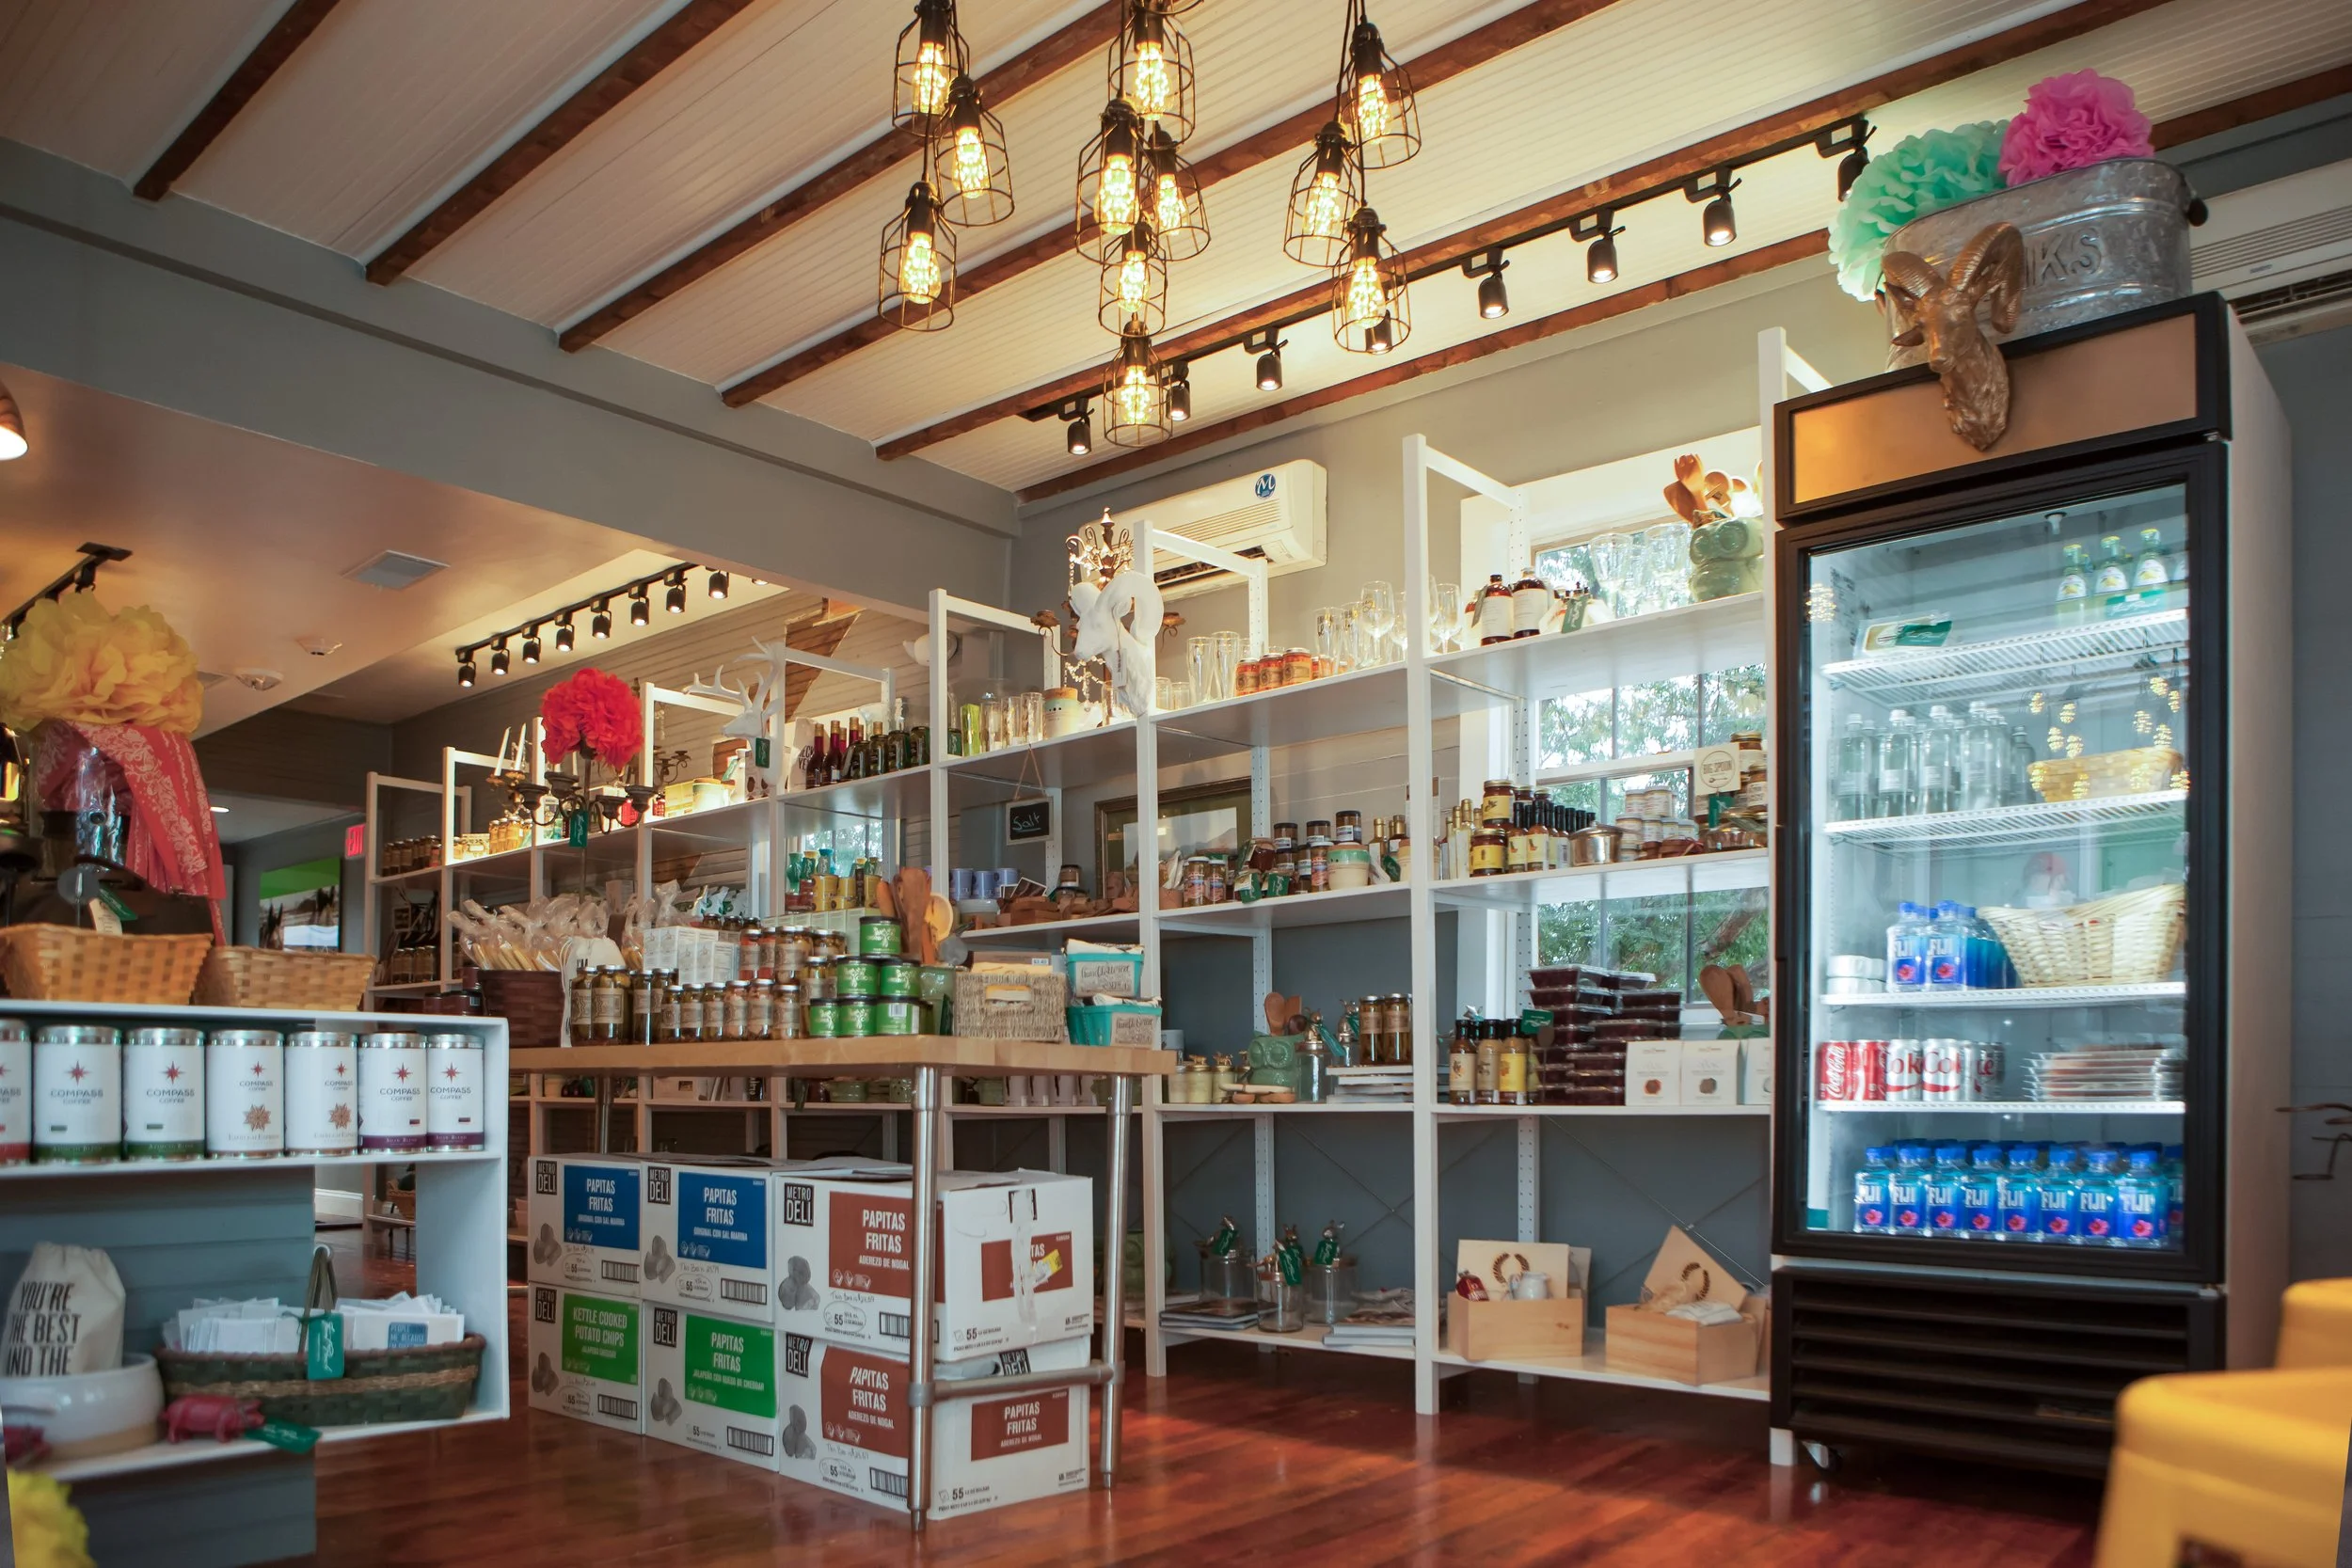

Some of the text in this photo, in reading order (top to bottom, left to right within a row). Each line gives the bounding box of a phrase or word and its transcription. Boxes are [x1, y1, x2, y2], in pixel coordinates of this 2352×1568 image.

[1012, 812, 1041, 831] Salt
[346, 824, 365, 856] EXIT
[51, 1088, 103, 1098] COMPASS
[147, 1088, 195, 1097] COMPASS
[379, 1087, 421, 1096] COMPASS
[537, 1163, 556, 1175] METRO
[649, 1168, 669, 1182] METRO
[586, 1178, 615, 1195] PAPITAS
[787, 1185, 811, 1201] METRO
[1893, 1185, 1916, 1204] FIJI
[589, 1196, 613, 1212] FRITAS
[704, 1187, 738, 1206] PAPITAS
[1929, 1187, 1952, 1206] FIJI
[1965, 1188, 1989, 1206] FIJI
[2041, 1191, 2067, 1209] FIJI
[2080, 1192, 2106, 1211] FIJI
[707, 1207, 735, 1226] FRITAS
[862, 1209, 906, 1232] PAPITAS
[693, 1227, 748, 1242] ORIGINAL CON SAL MARINA
[866, 1232, 902, 1254] FRITAS
[859, 1255, 910, 1271] ADEREZO DE NOGAL
[686, 1280, 693, 1291] 55
[20, 1281, 74, 1311] YOU'RE
[537, 1290, 555, 1303] METRO
[573, 1307, 628, 1329] KETTLE COOKED
[656, 1309, 676, 1324] METRO
[834, 1313, 844, 1325] 55
[34, 1312, 82, 1345] BEST
[575, 1324, 625, 1347] POTATO CHIPS
[966, 1327, 977, 1340] 55
[710, 1332, 744, 1354] PAPITAS
[787, 1336, 810, 1351] METRO
[39, 1345, 74, 1377] THE
[712, 1352, 741, 1373] FRITAS
[1002, 1349, 1025, 1365] METRO
[743, 1378, 765, 1391] CHEDDAR
[850, 1366, 889, 1390] PAPITAS
[567, 1394, 575, 1405] 55
[852, 1388, 887, 1412] FRITAS
[1004, 1401, 1041, 1421] PAPITAS
[848, 1410, 895, 1430] ADEREZO DE NOGAL
[1007, 1418, 1037, 1435] FRITAS
[692, 1425, 700, 1437] 55
[1022, 1435, 1028, 1445] DE
[830, 1465, 838, 1478] 55
[952, 1487, 964, 1500] 55
